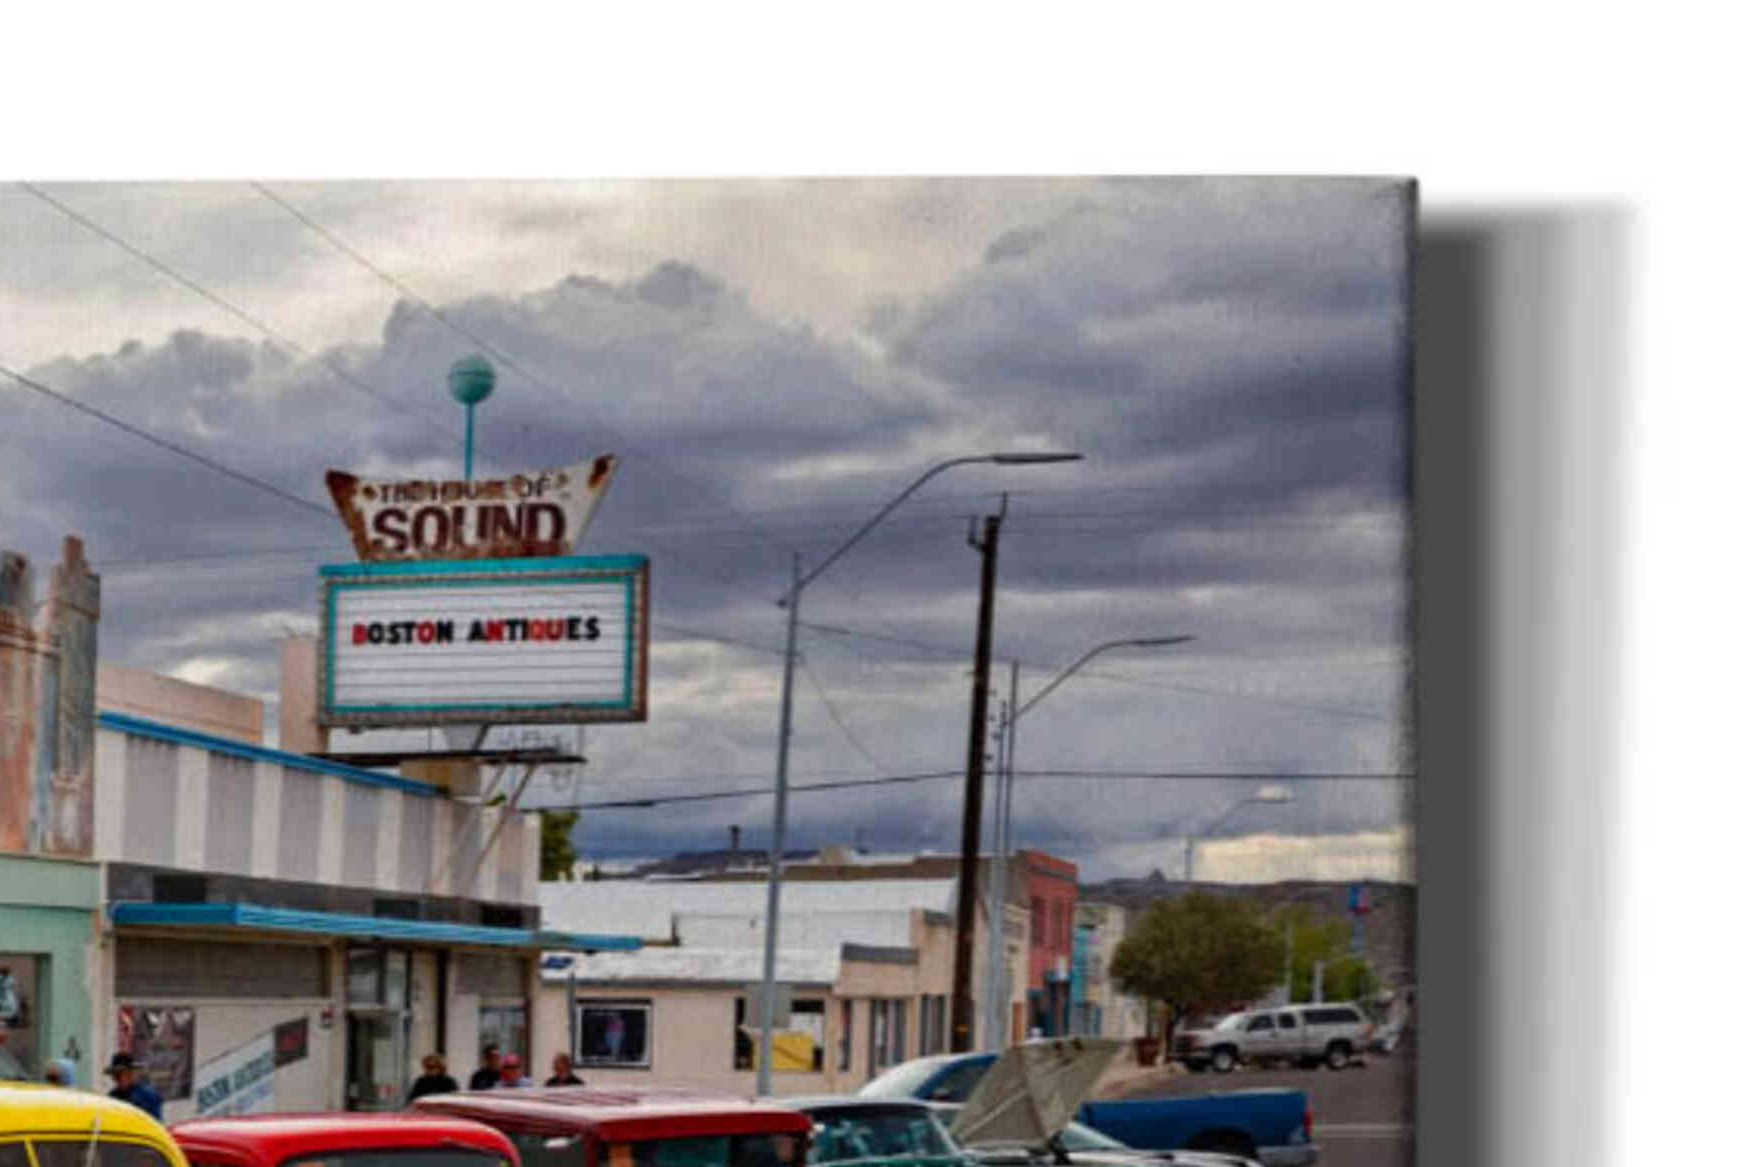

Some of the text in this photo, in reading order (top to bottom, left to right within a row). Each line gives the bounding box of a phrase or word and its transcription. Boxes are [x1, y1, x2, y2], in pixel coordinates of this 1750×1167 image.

[511, 472, 553, 499] OF
[372, 502, 567, 552] SOUND
[350, 617, 601, 646] BOSTON ANTIQUES
